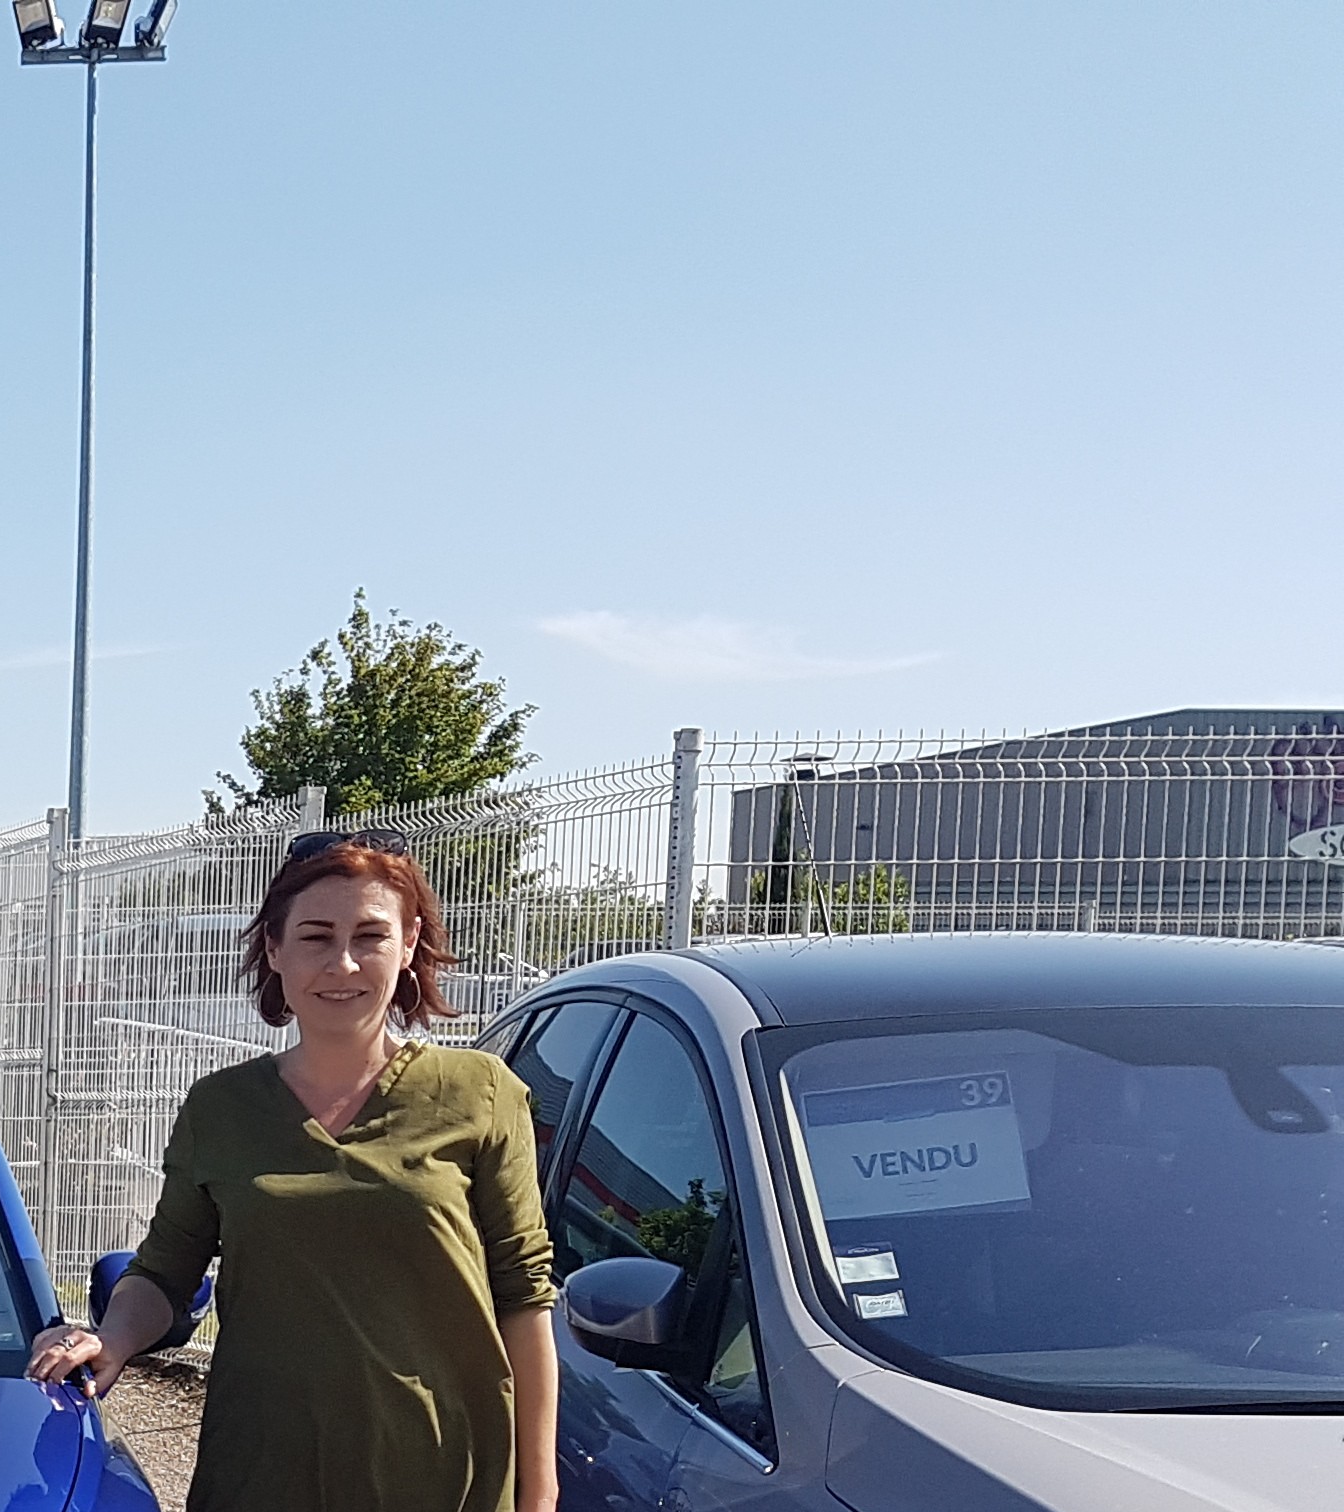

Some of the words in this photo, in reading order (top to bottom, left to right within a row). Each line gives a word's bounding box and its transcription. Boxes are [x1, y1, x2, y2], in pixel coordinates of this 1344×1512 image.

[1319, 830, 1344, 857] S
[960, 1078, 1003, 1106] 39
[852, 1142, 979, 1179] VENDU
